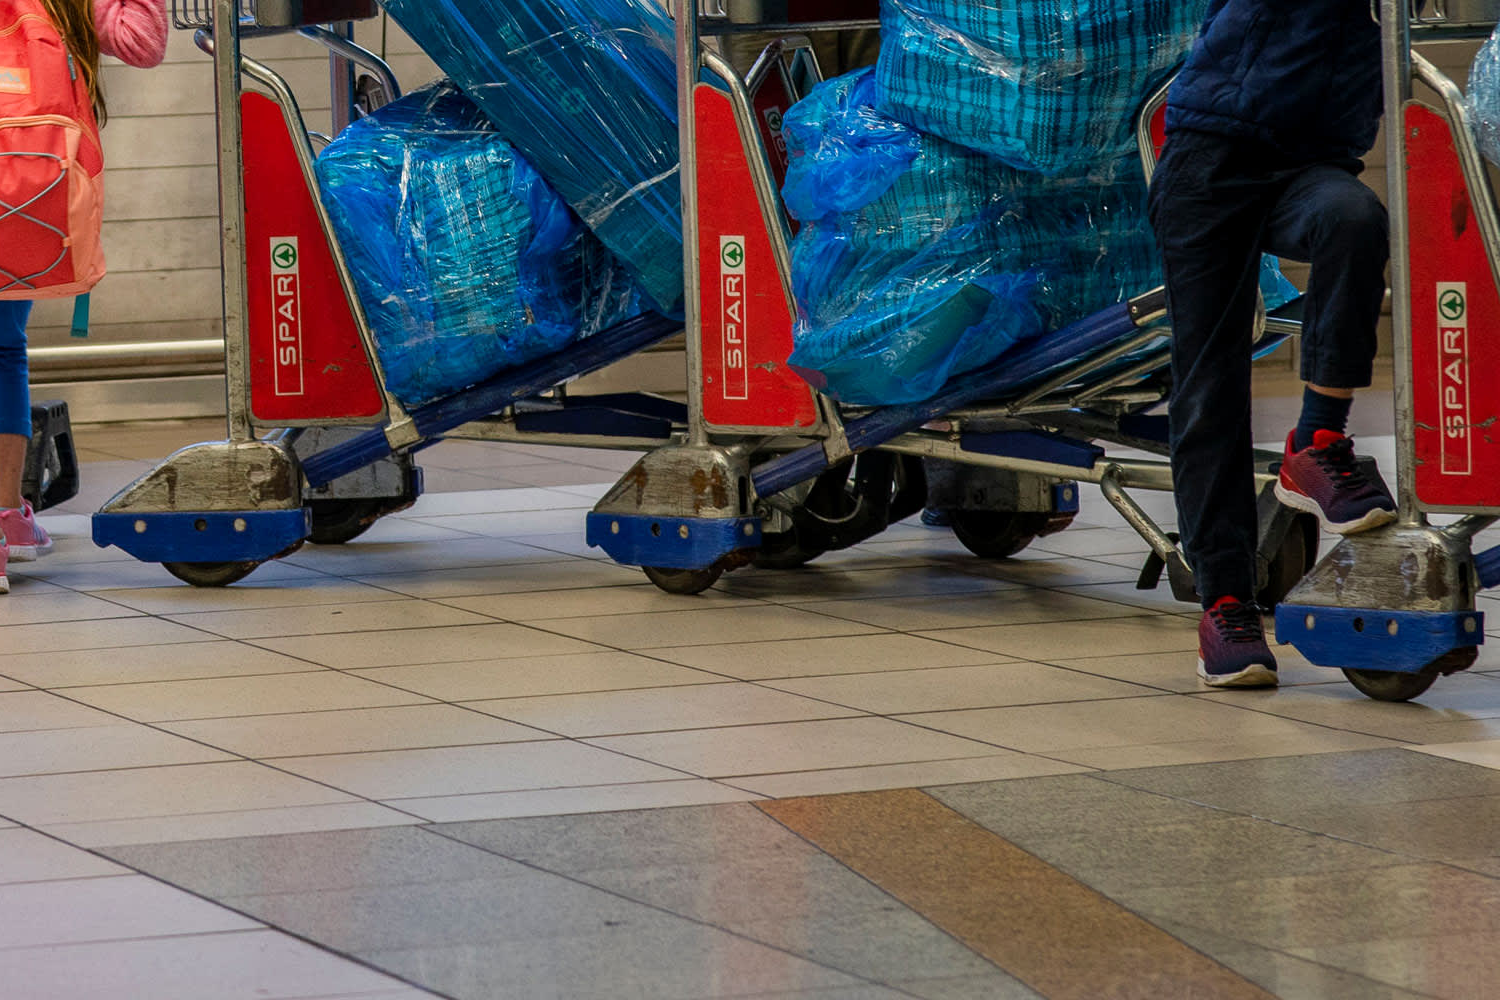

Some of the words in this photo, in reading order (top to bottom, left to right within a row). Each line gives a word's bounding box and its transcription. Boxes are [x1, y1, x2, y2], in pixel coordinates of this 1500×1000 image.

[277, 275, 297, 366] SPAR
[725, 276, 742, 369] SPAR
[1443, 329, 1464, 439] SPAR
